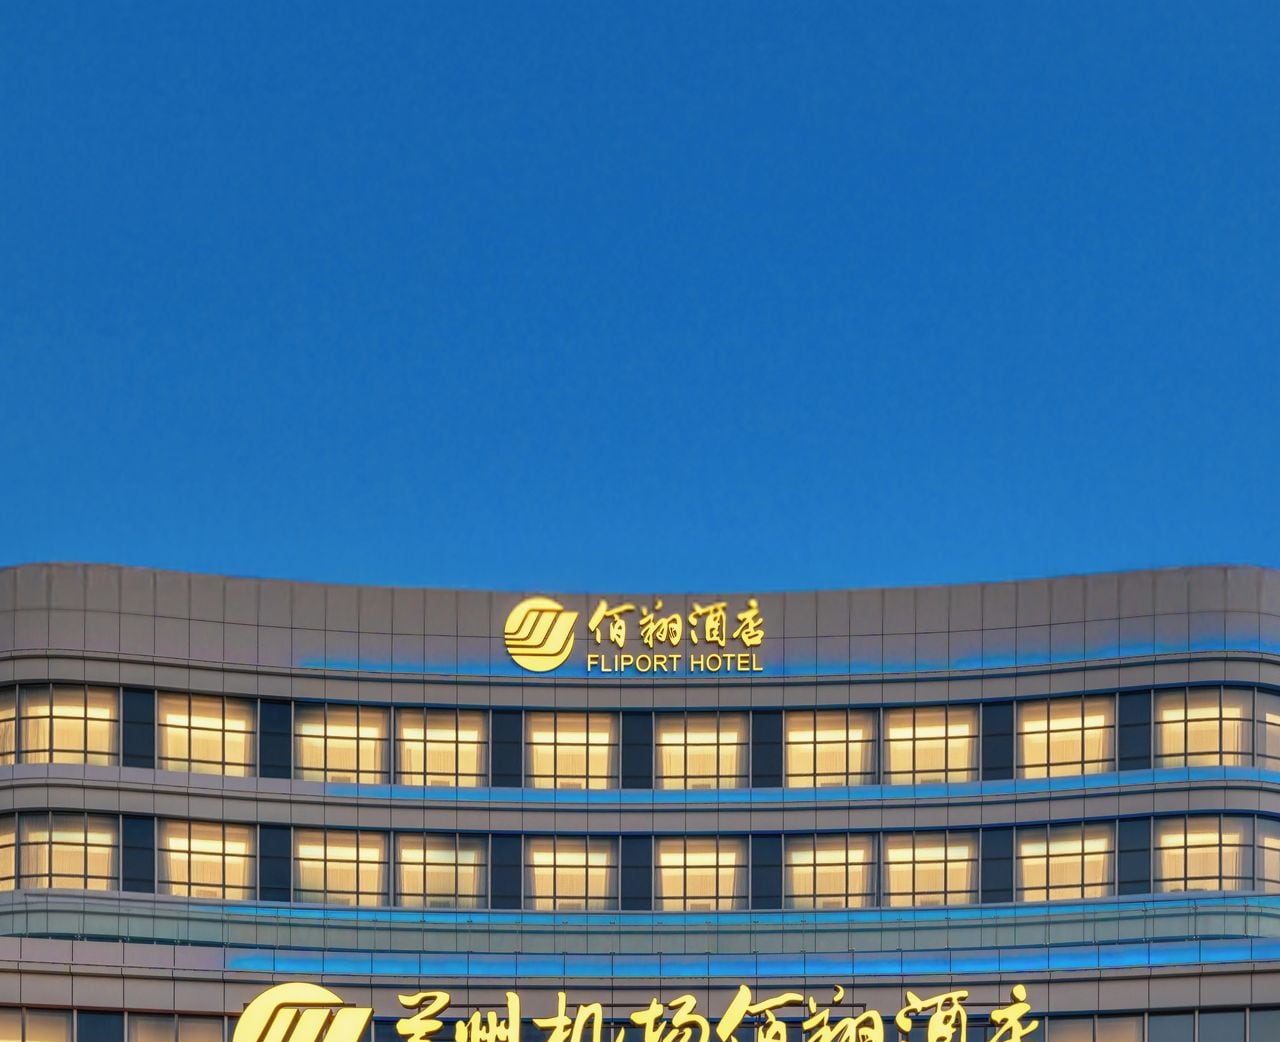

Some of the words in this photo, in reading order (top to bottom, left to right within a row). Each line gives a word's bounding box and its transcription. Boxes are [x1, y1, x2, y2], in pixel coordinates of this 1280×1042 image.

[587, 599, 766, 649] 佰翔酒店
[587, 653, 682, 672] FLIPORT
[690, 653, 763, 672] HOTEL
